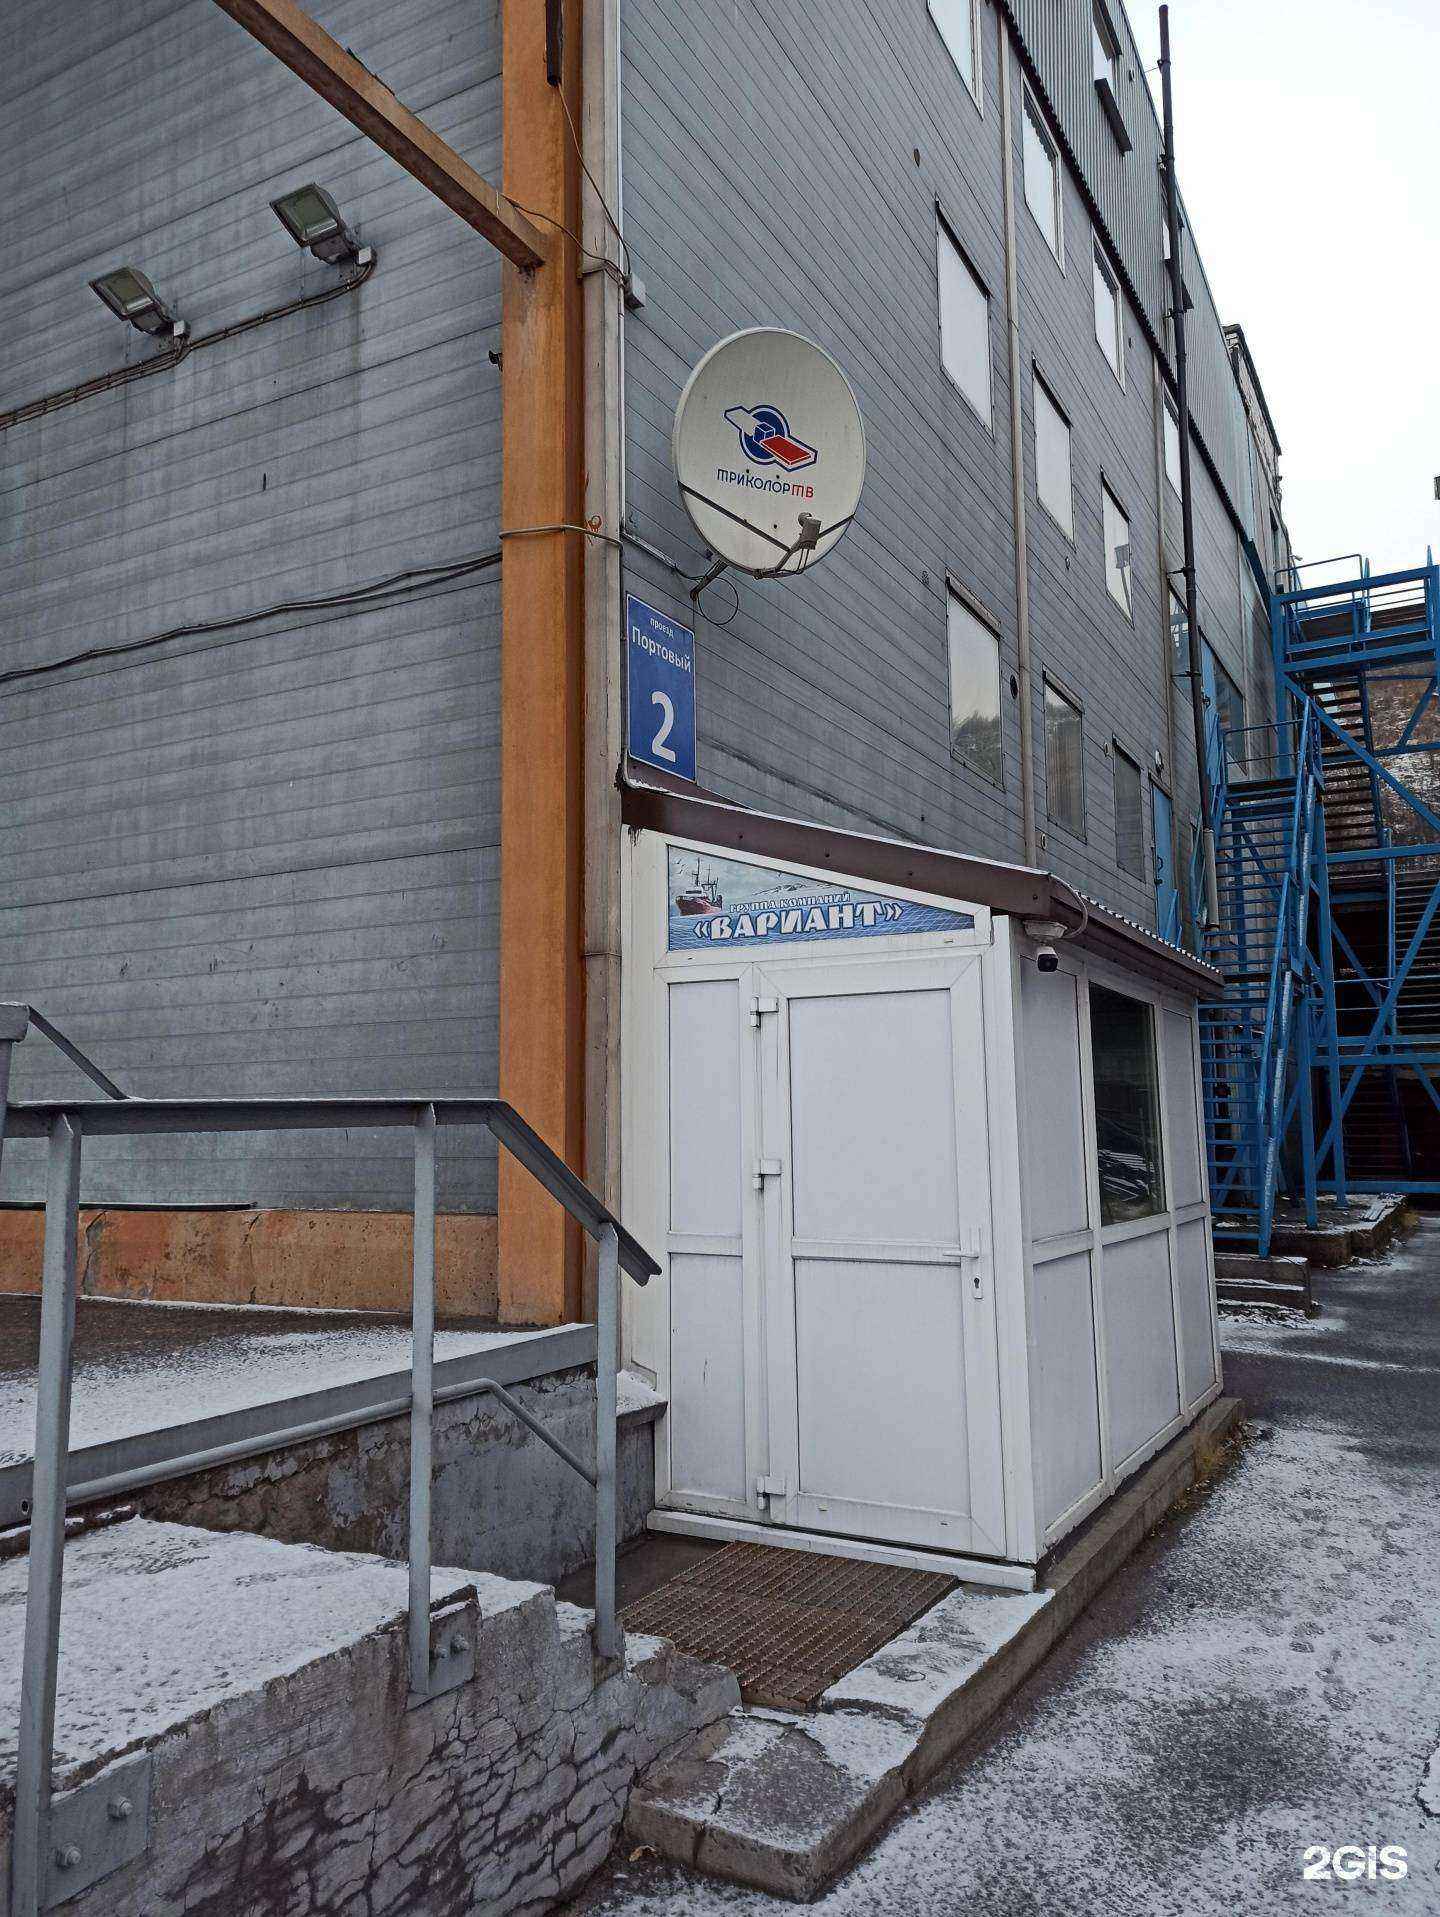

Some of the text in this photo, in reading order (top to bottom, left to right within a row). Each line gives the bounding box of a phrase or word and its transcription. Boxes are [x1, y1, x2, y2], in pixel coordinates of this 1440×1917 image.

[650, 617, 674, 638] проезд
[632, 626, 691, 673] Портовый
[651, 690, 676, 763] 2
[693, 900, 904, 941] «ВАРИАНТ»
[729, 892, 851, 914] ГРУППА КОМПАНИЙ
